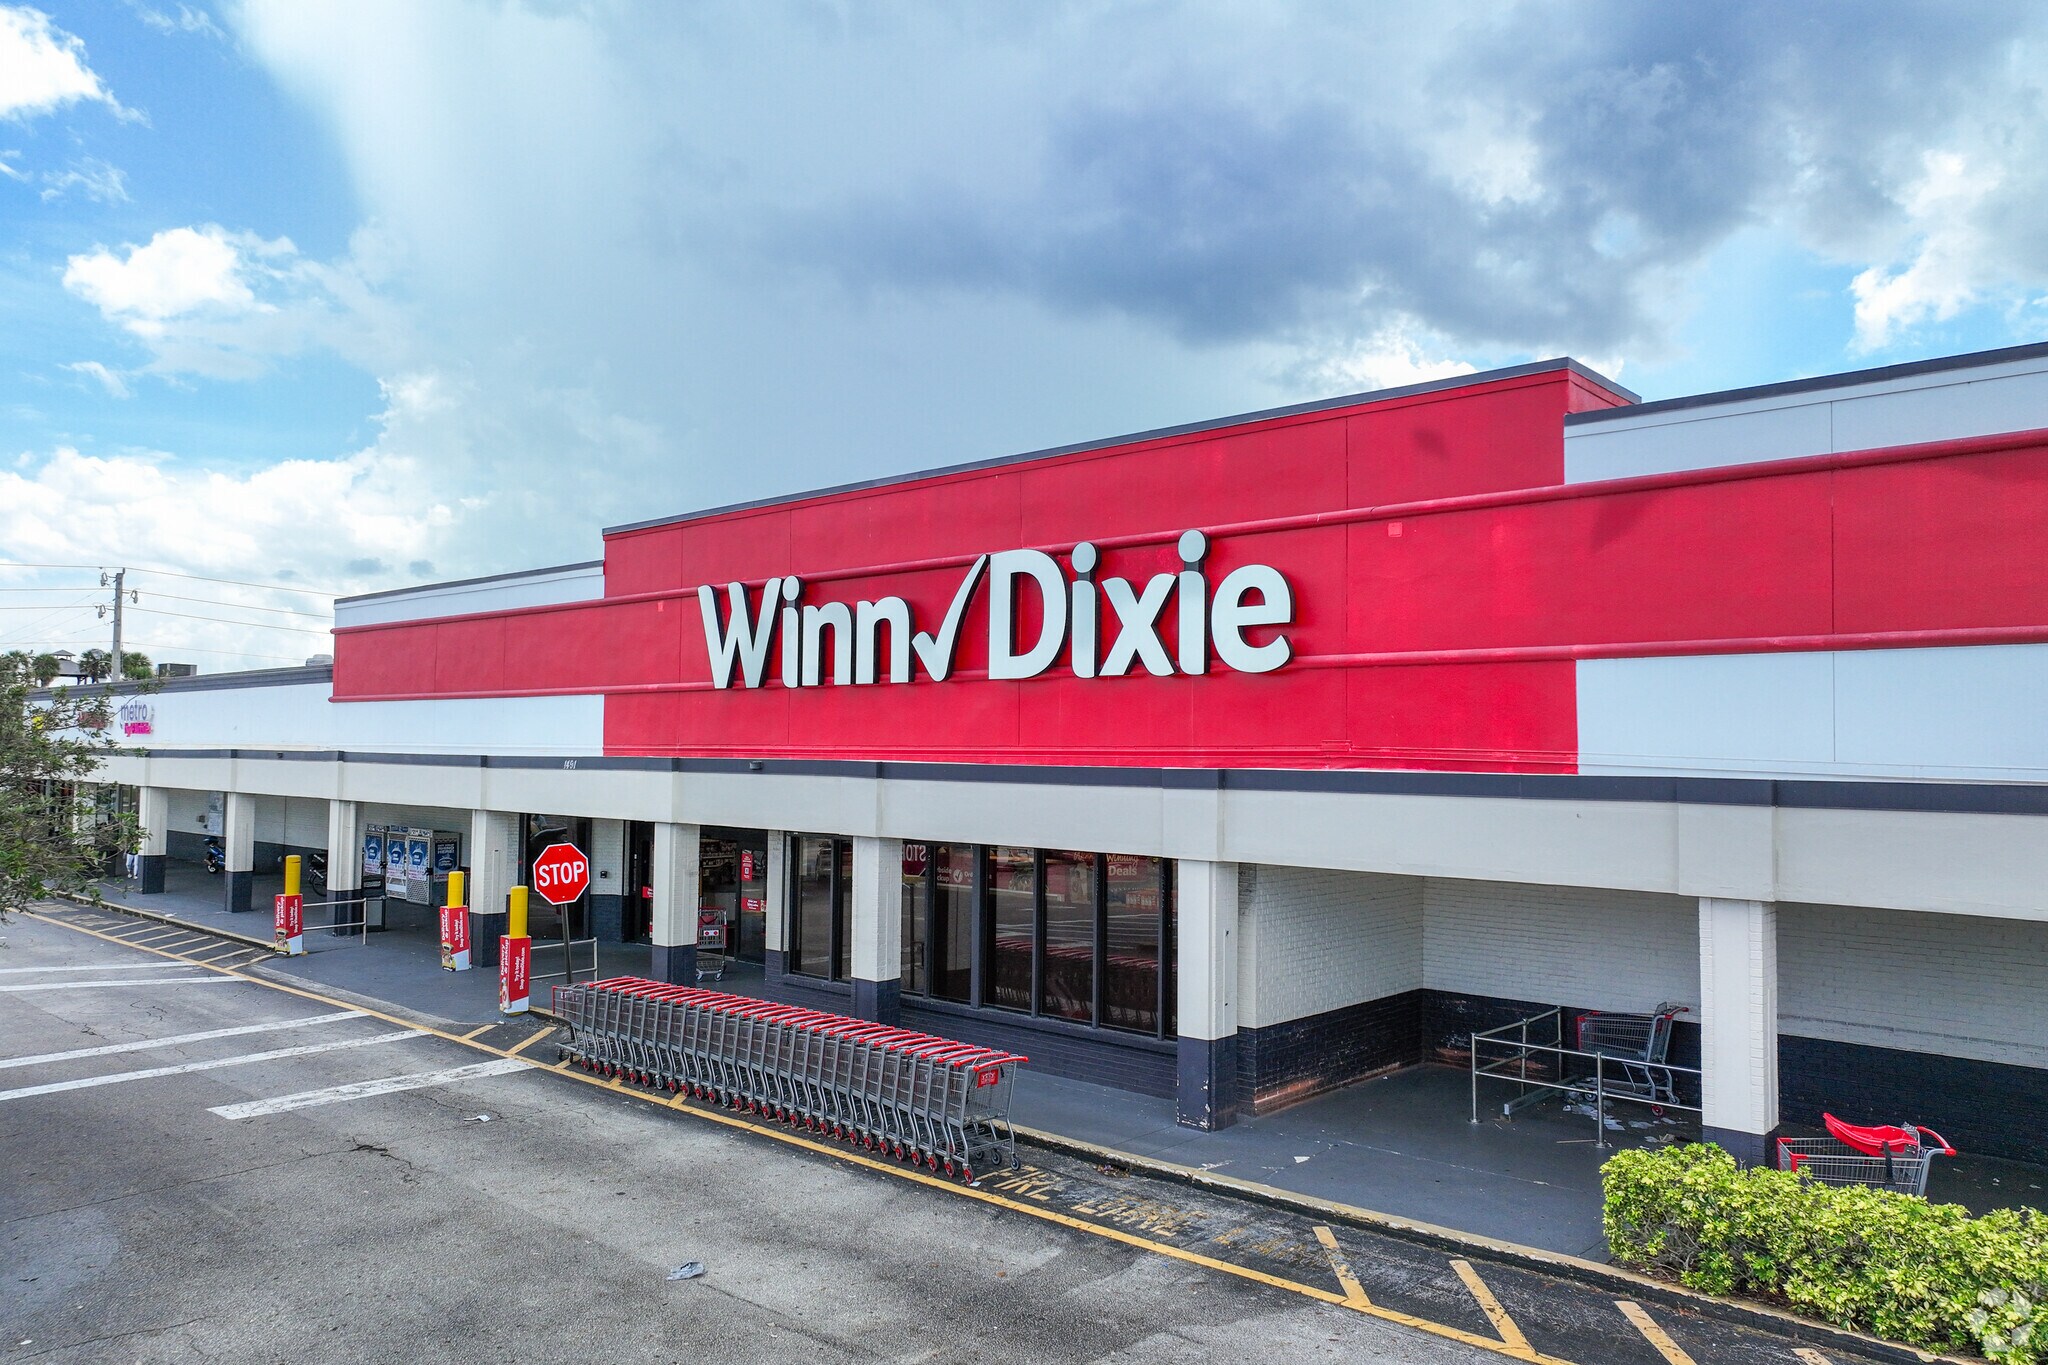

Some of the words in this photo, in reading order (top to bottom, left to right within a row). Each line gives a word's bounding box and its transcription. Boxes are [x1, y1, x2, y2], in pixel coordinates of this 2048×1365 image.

[697, 574, 913, 689] Winn
[988, 529, 1293, 680] Dixie
[120, 700, 148, 721] metro
[539, 861, 585, 887] STOP
[1108, 865, 1137, 876] Deals
